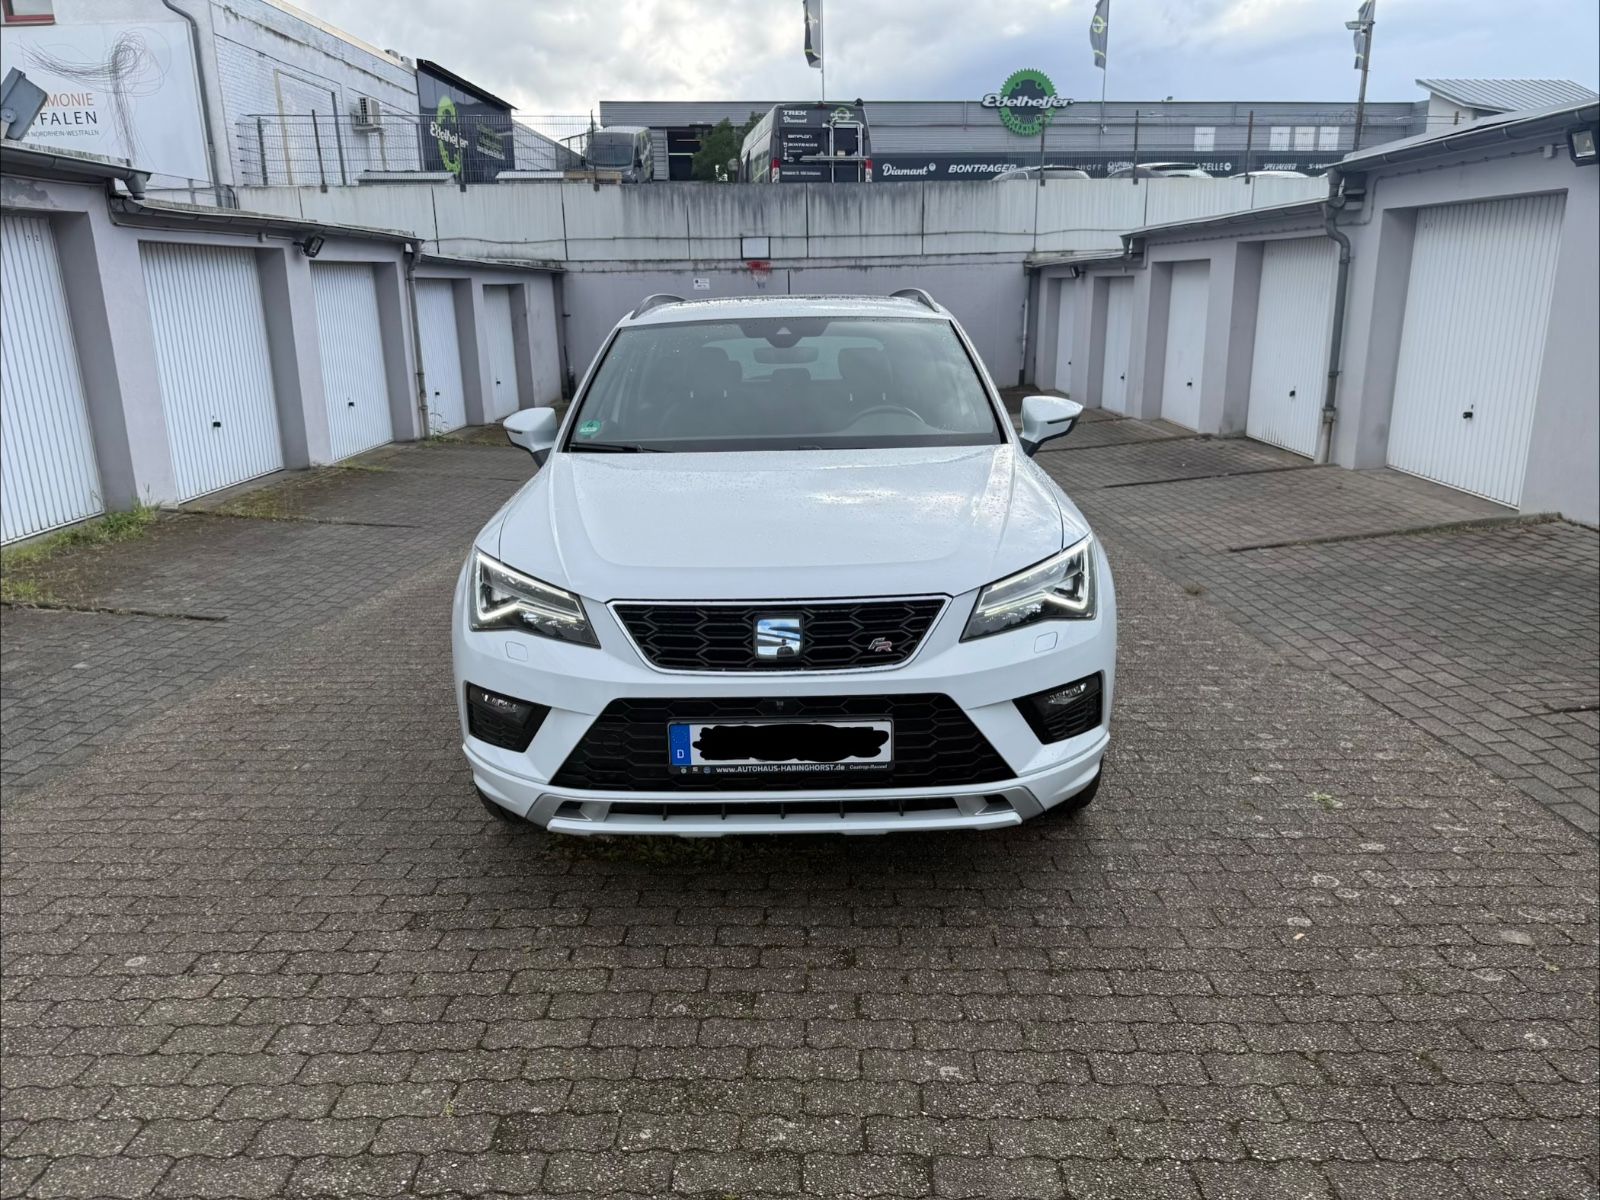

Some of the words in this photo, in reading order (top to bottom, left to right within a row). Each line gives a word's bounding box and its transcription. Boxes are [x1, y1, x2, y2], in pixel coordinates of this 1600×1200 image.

[44, 92, 95, 108] MONIE
[982, 93, 1074, 109] Edelhelfer
[34, 111, 98, 126] FALEN
[882, 163, 928, 176] Diamant
[948, 164, 1017, 174] BONTRAGER
[677, 749, 685, 759] D
[716, 764, 846, 773] www.AUTOHAUS-HABINGHORST.de
